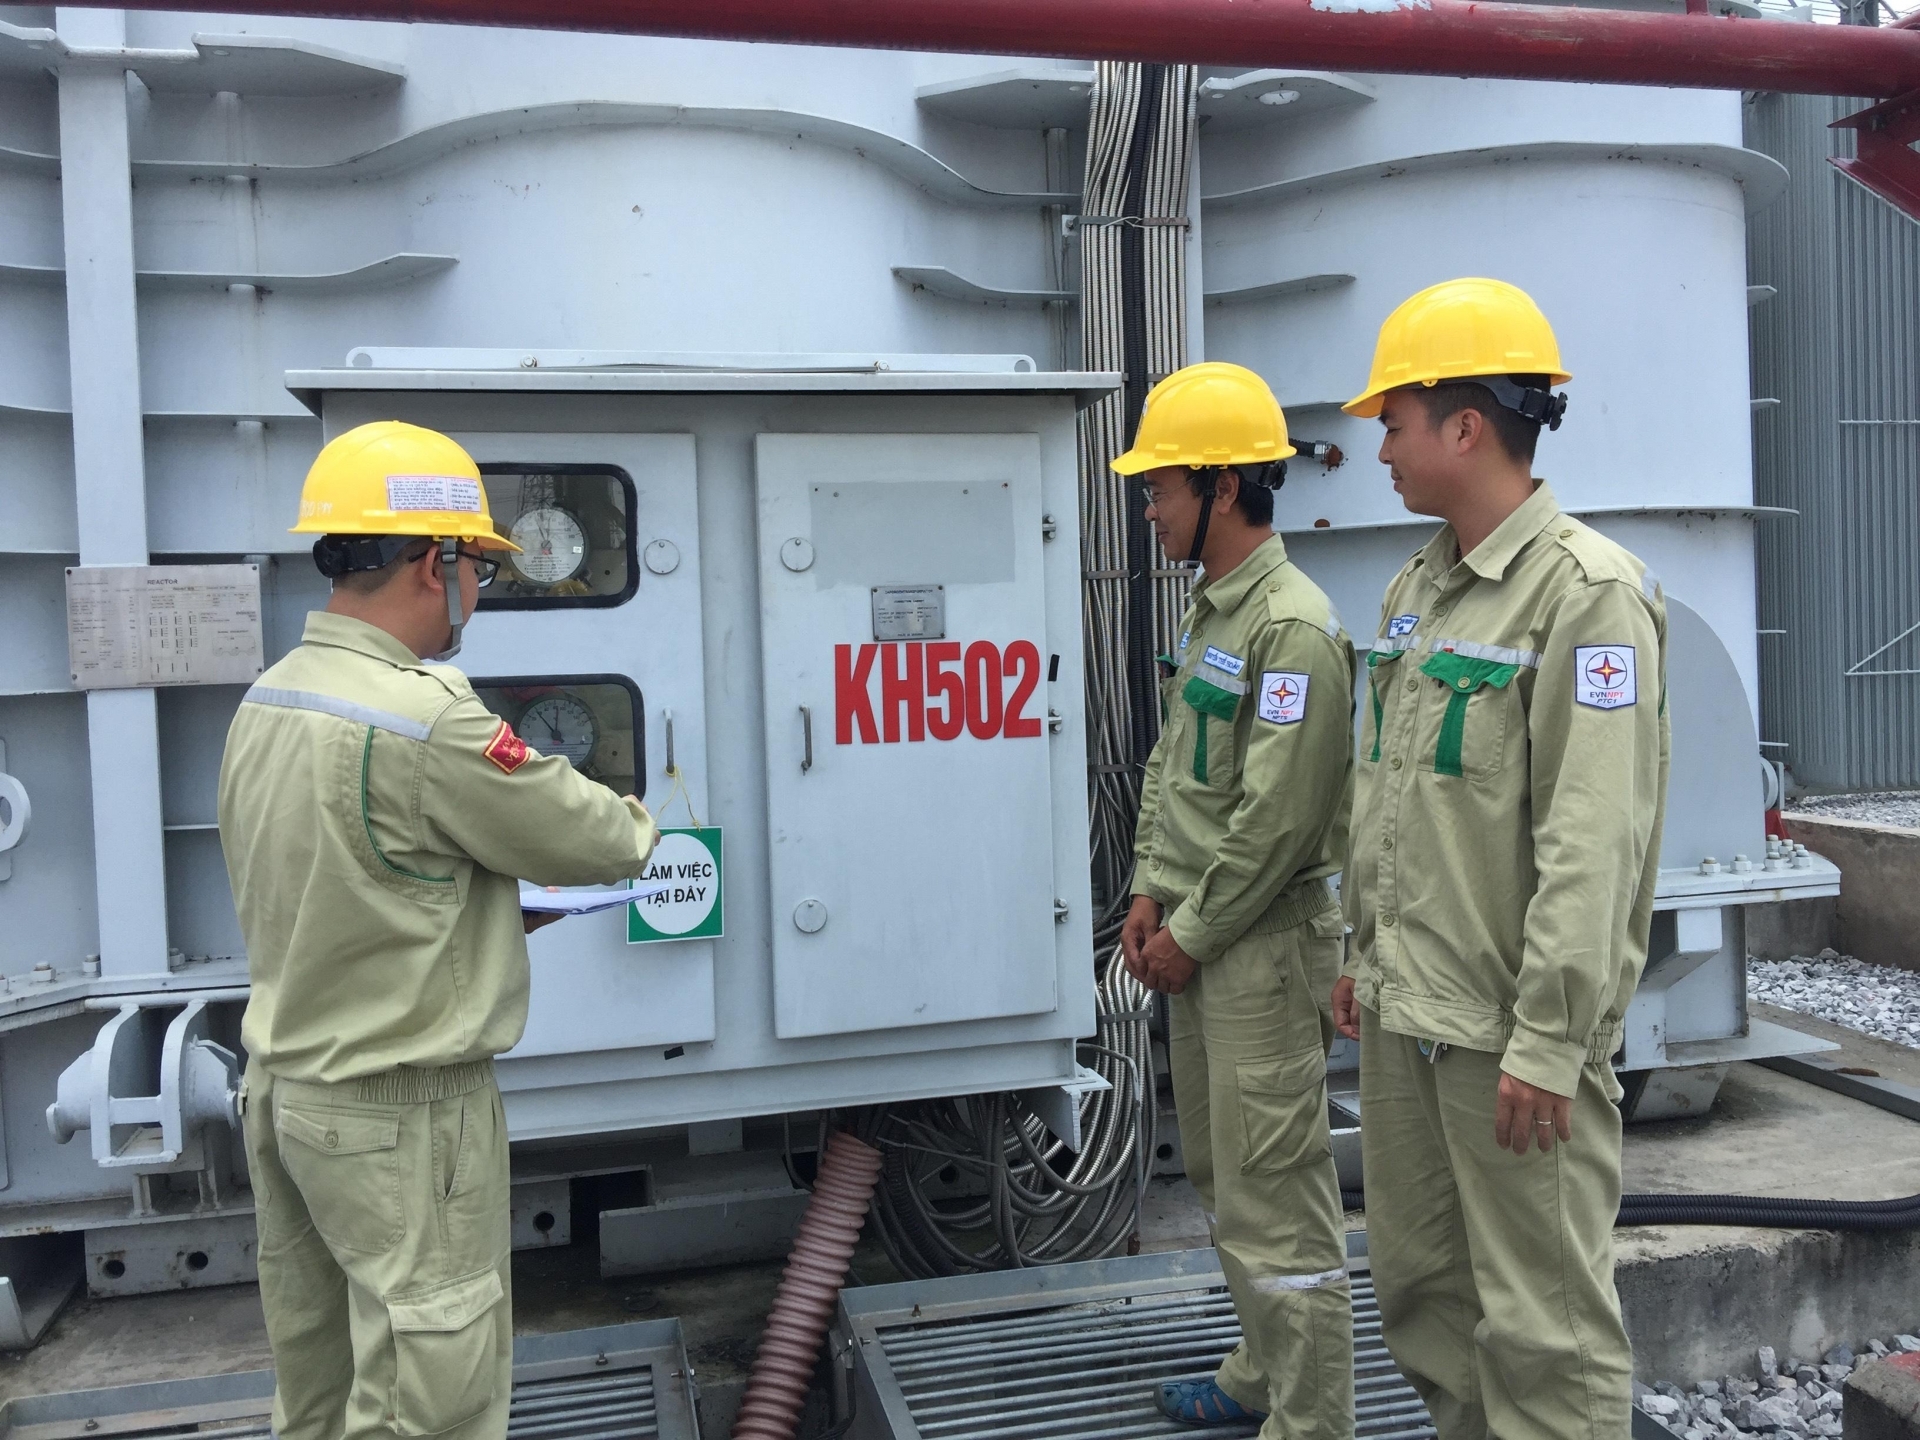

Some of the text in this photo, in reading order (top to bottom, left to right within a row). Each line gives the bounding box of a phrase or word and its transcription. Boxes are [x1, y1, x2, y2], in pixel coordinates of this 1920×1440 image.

[835, 640, 1041, 744] KH502
[677, 861, 712, 882] VIỆC
[674, 885, 706, 903] ĐÂY
